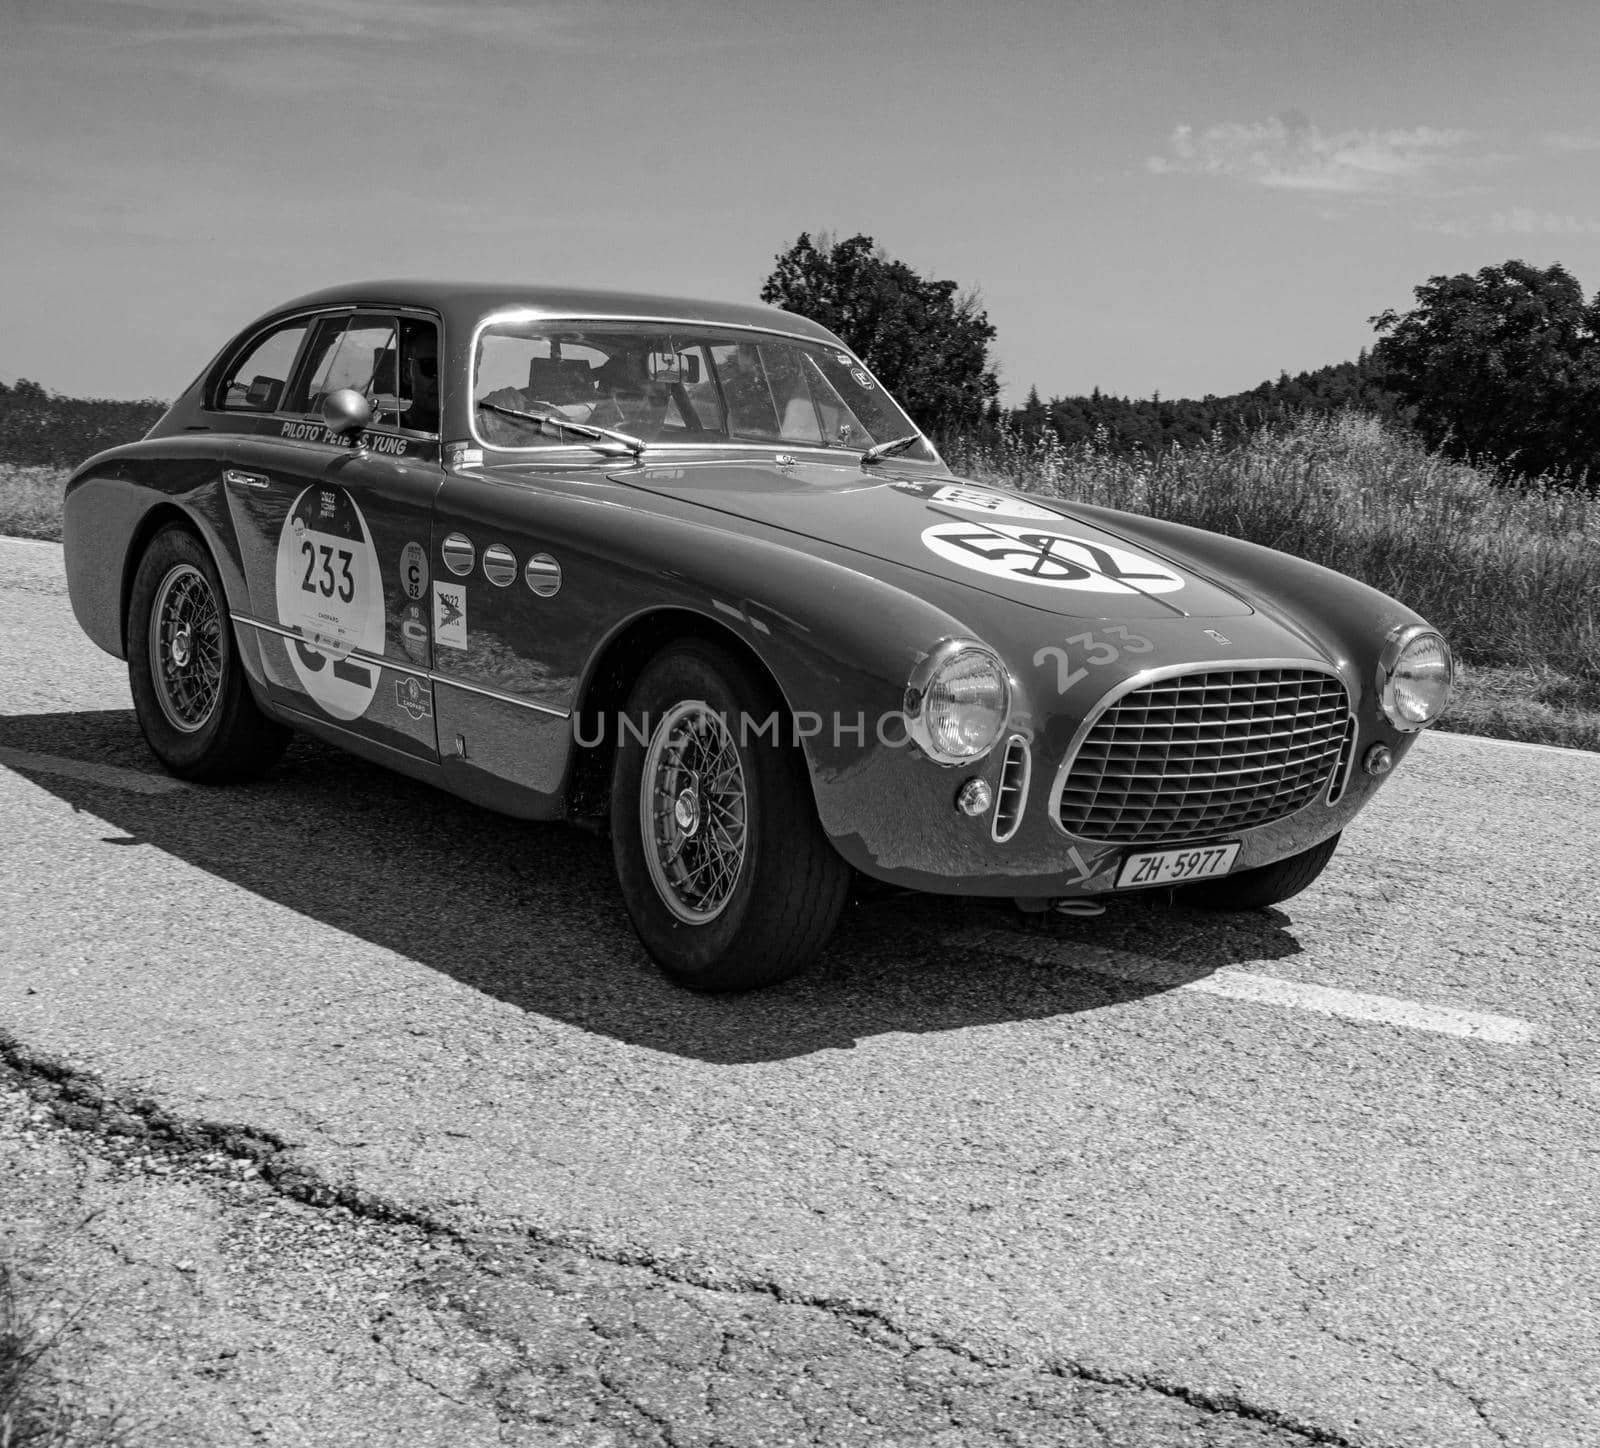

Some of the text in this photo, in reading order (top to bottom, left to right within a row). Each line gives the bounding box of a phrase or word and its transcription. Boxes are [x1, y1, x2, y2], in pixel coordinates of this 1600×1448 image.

[371, 435, 409, 456] YUNG
[301, 540, 355, 604] 233
[407, 565, 421, 585] C
[1033, 623, 1155, 696] 233
